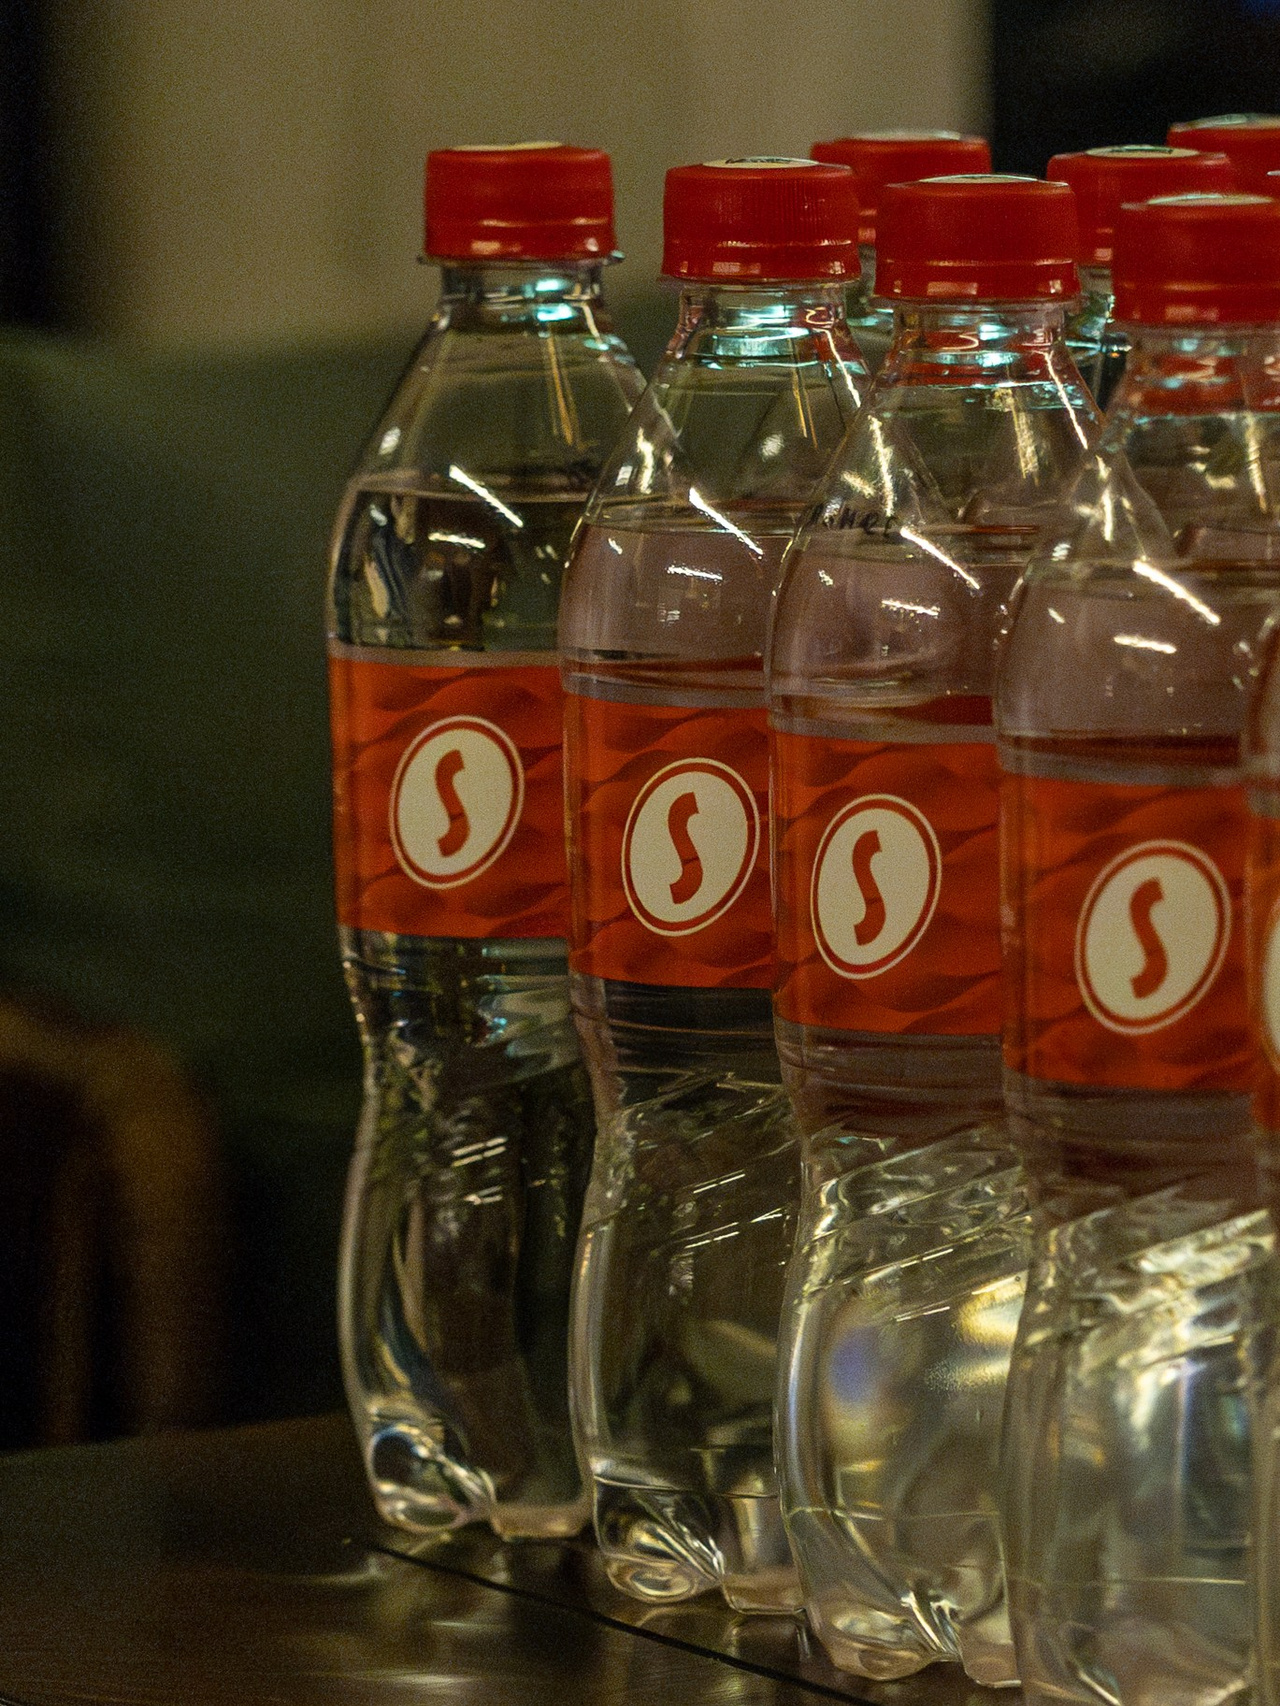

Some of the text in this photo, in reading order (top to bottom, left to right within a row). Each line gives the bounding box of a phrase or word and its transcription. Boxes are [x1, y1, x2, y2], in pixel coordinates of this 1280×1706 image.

[434, 749, 470, 857] S
[667, 791, 704, 905] S
[852, 829, 887, 946] S
[1130, 876, 1169, 999] S
